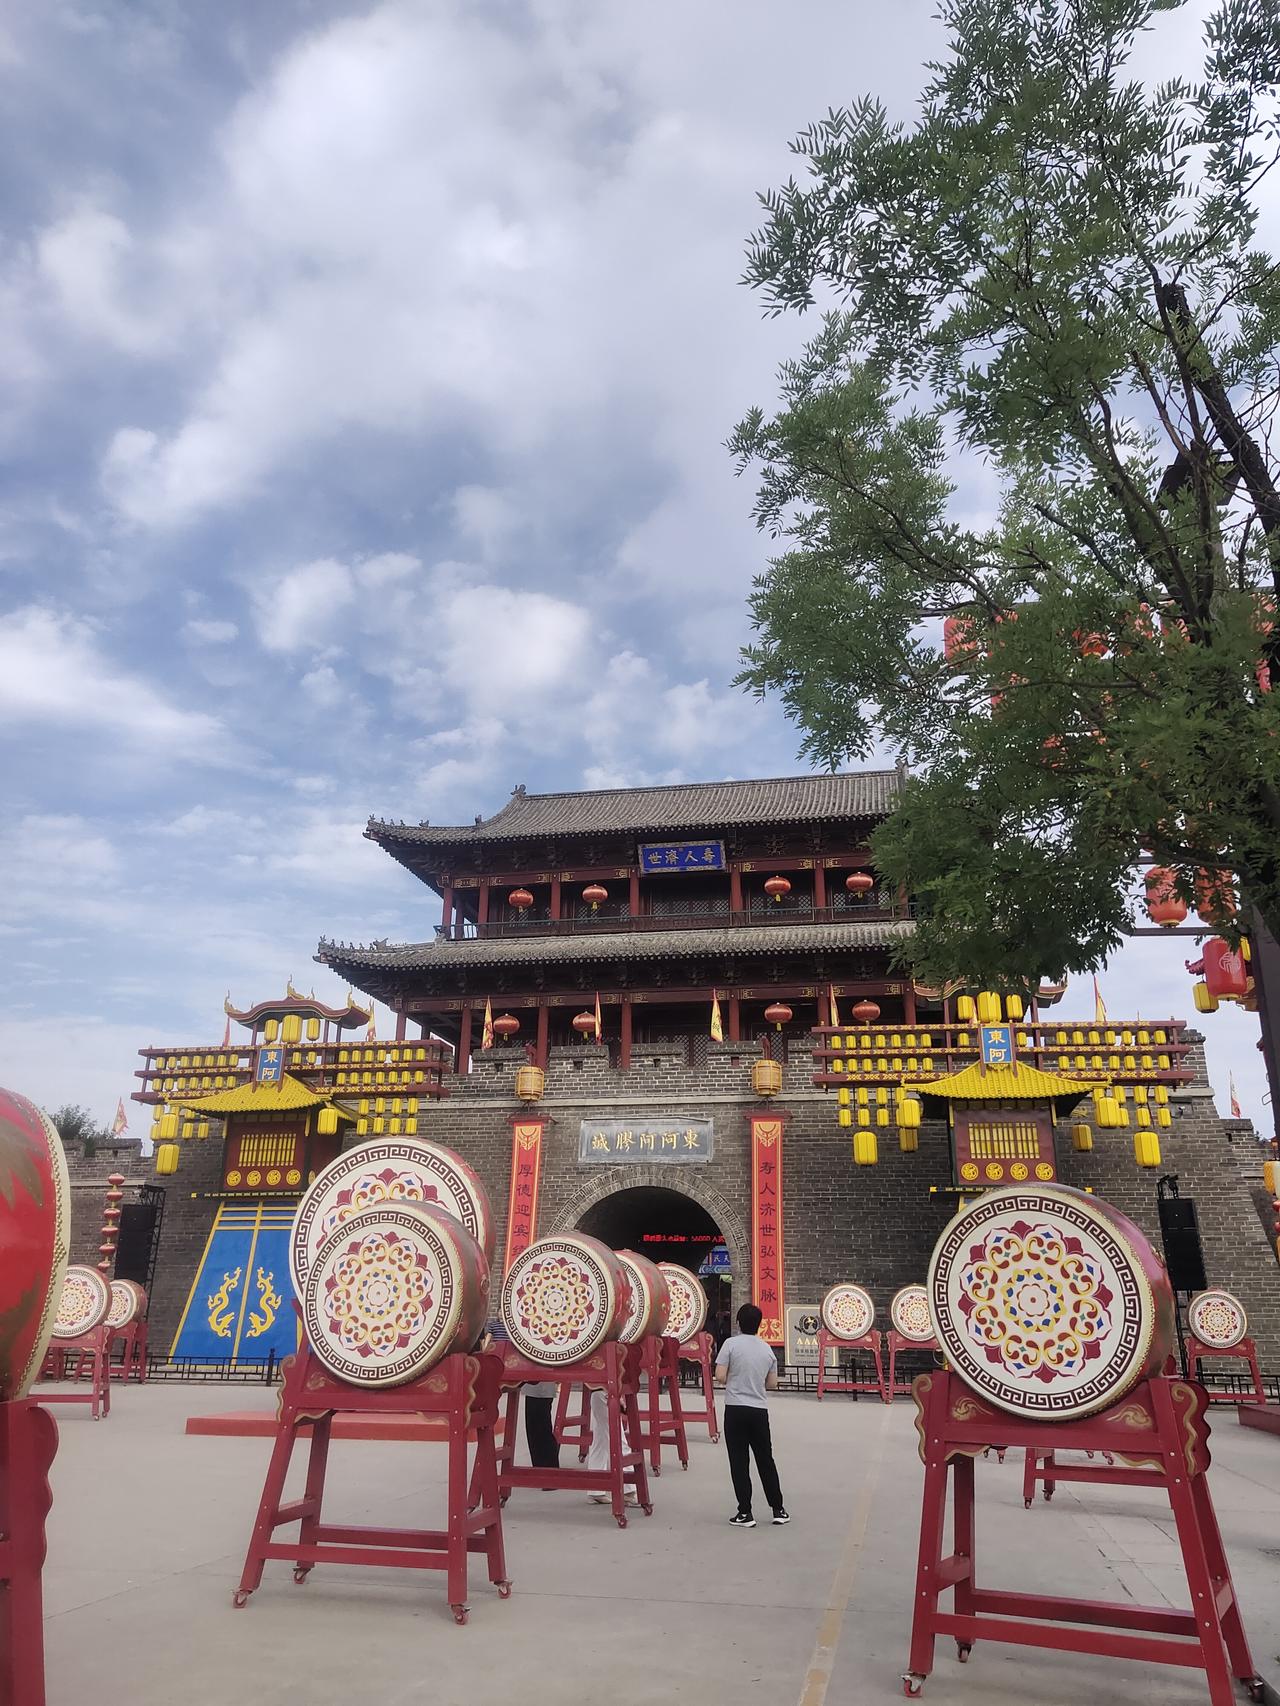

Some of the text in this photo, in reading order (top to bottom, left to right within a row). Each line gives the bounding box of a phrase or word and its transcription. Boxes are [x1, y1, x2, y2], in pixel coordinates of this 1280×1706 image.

[987, 1029, 1007, 1062] 東阿
[262, 1050, 280, 1081] 東阿
[759, 1161, 777, 1304] 寿人济世弘文脉
